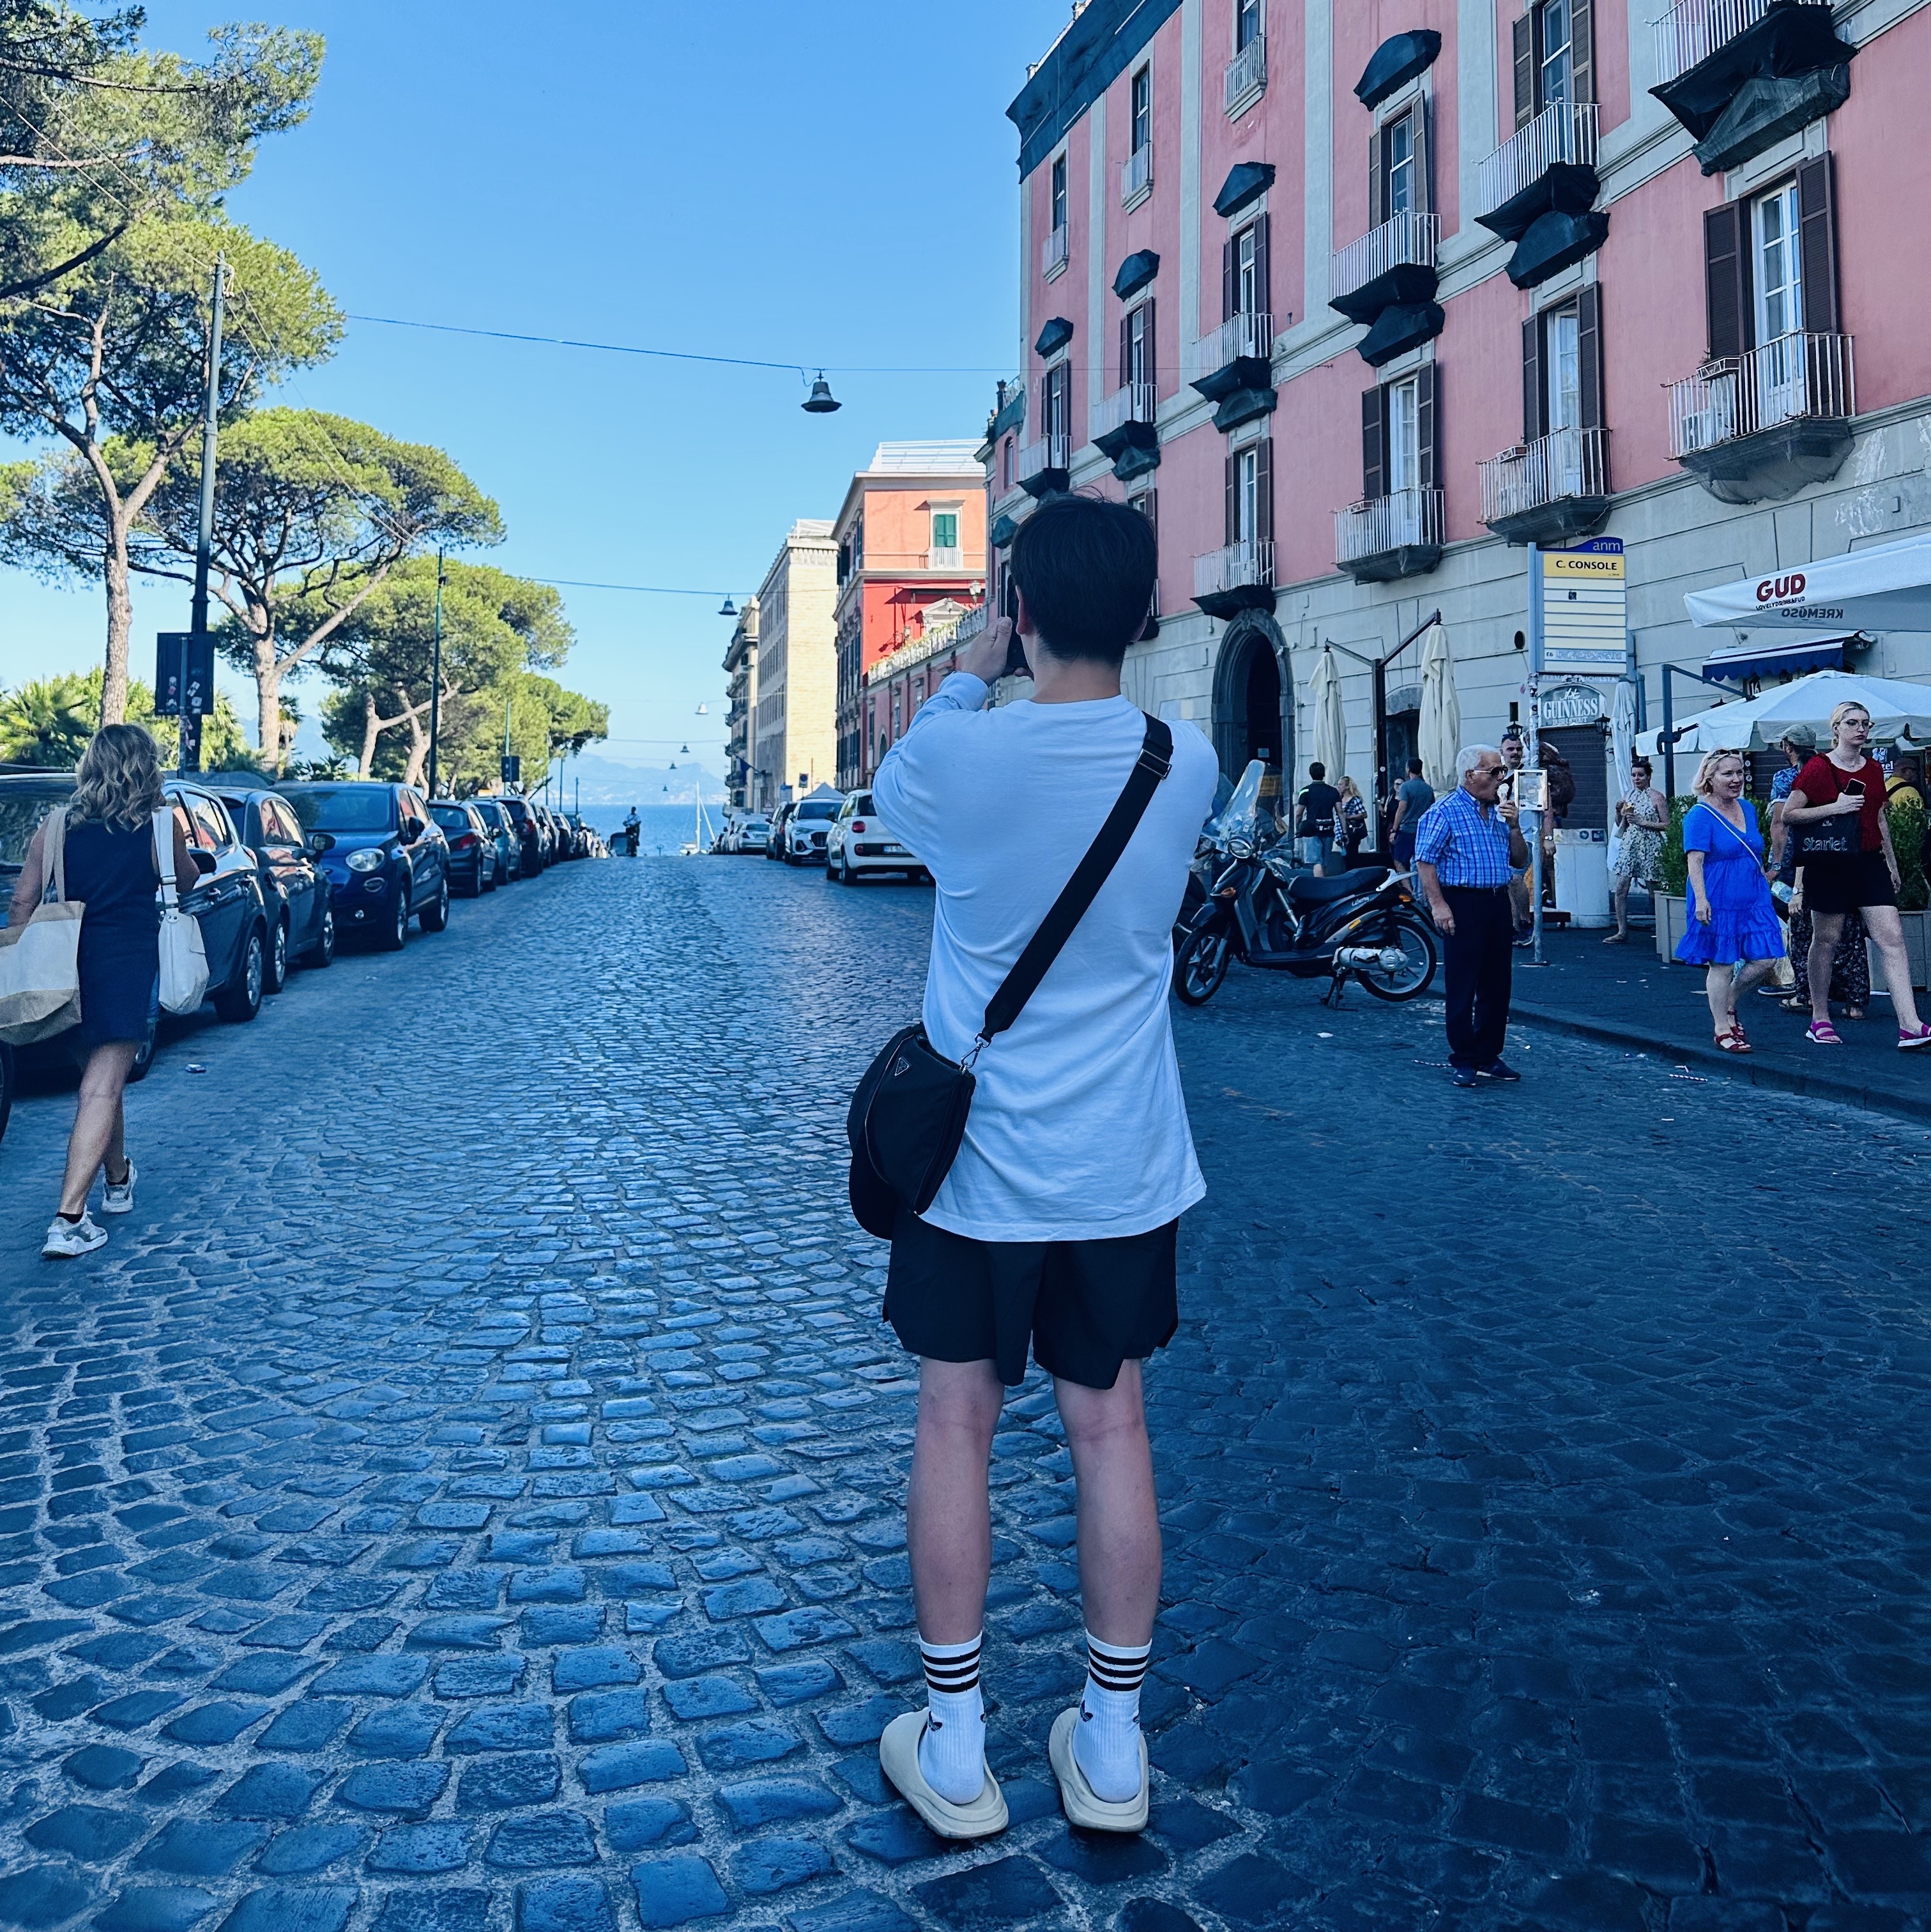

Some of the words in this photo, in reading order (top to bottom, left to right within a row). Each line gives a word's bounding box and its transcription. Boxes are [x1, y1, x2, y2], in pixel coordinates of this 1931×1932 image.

[1592, 541, 1621, 551] anm
[1556, 560, 1566, 569] C.
[1568, 560, 1617, 571] CONSOLE
[1756, 573, 1806, 602] GUD
[1543, 698, 1598, 719] GUINNESS
[1802, 836, 1848, 852] Starlet
